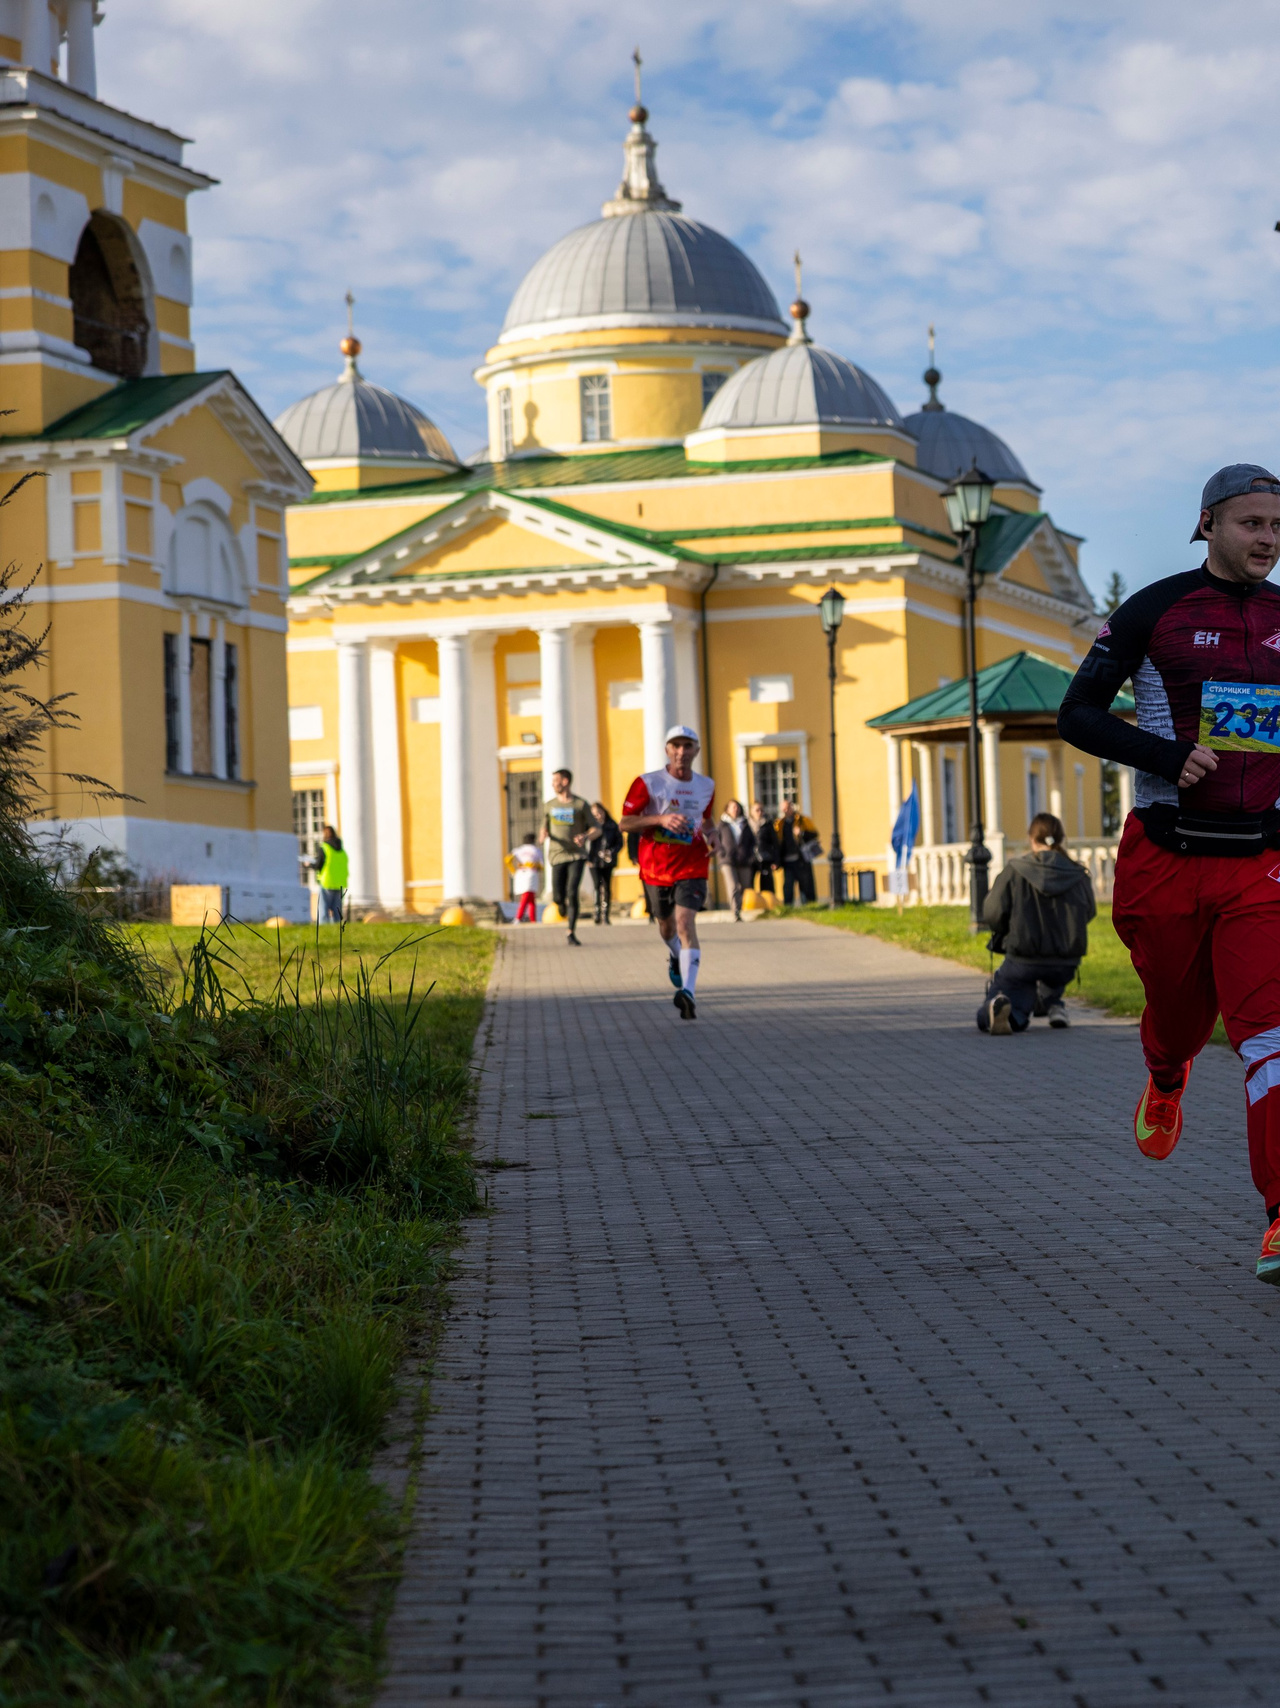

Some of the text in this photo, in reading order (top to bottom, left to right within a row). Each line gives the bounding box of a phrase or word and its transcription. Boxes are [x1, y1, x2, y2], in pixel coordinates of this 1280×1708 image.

[1193, 631, 1221, 645] EH
[1209, 686, 1250, 695] СТАРИЦКИЕ
[1209, 702, 1280, 740] 234
